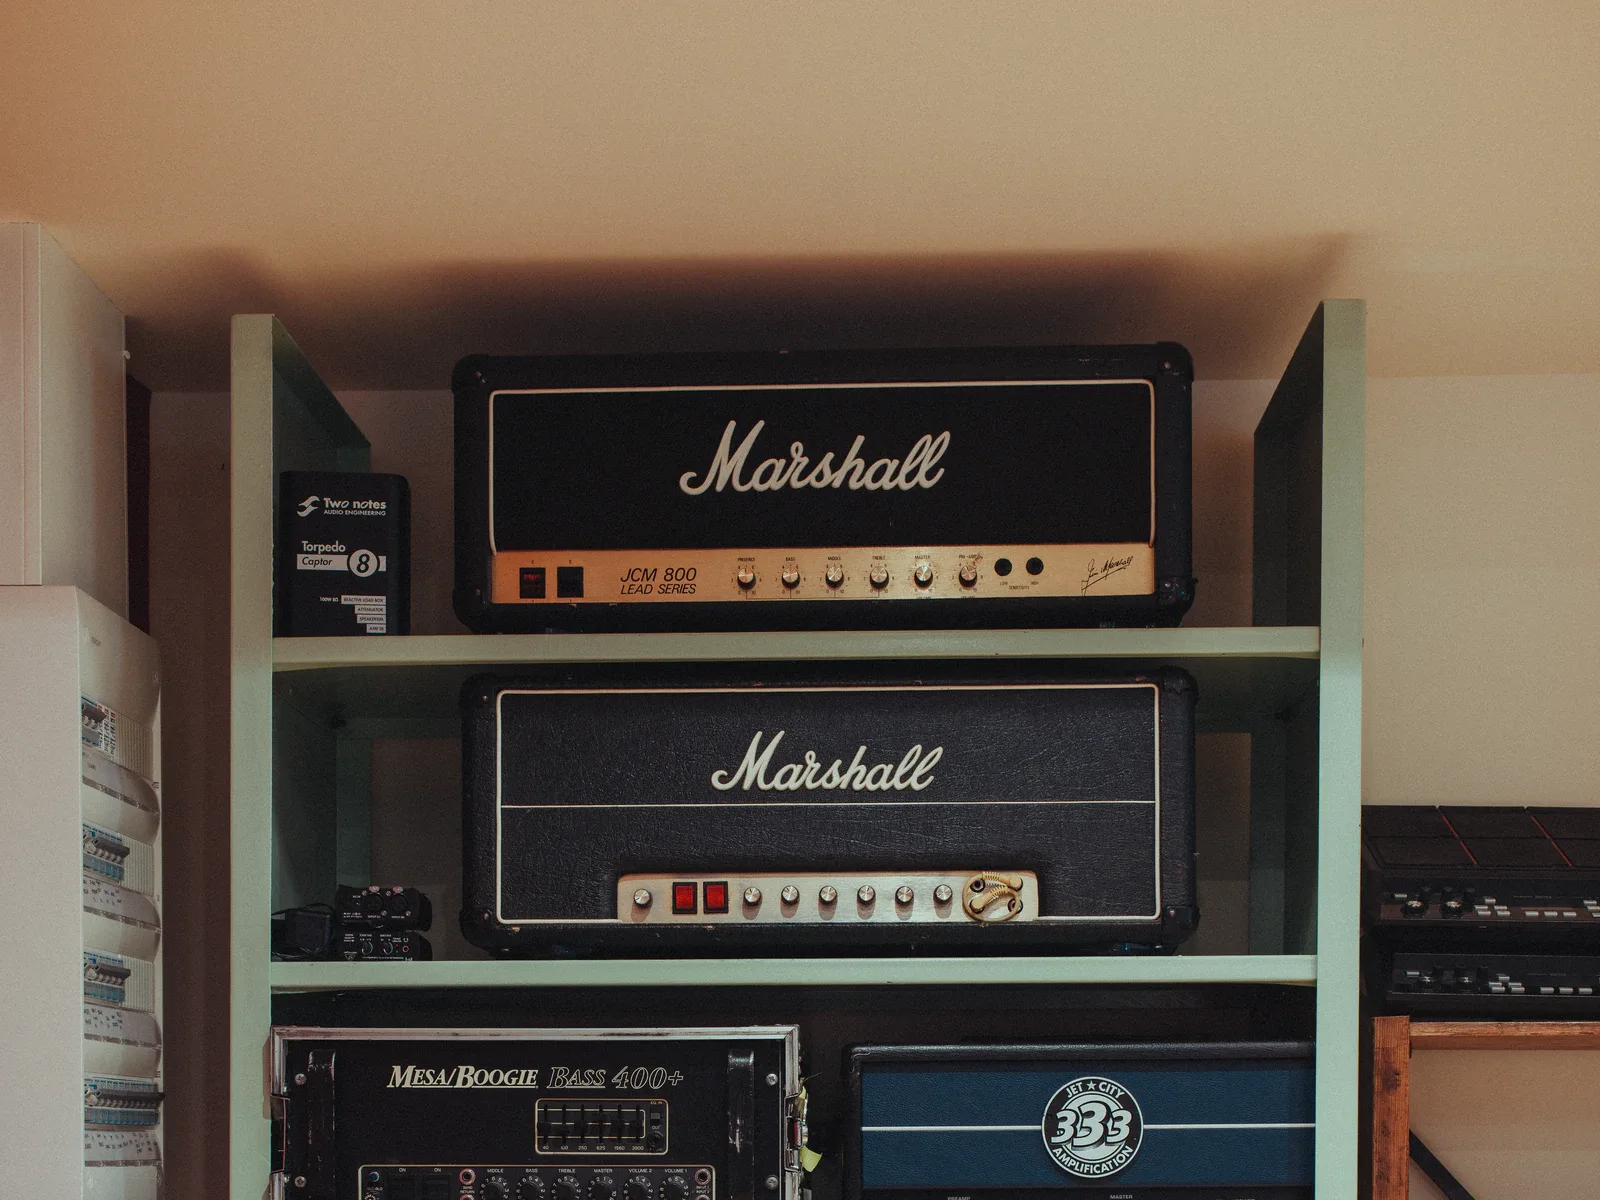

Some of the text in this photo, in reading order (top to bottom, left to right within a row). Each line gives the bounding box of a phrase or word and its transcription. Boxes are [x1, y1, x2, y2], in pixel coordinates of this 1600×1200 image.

[679, 420, 950, 495] Marshall
[324, 498, 386, 509] Two notes
[302, 541, 346, 554] Torpedo
[302, 557, 332, 568] Captor
[356, 554, 370, 573] 8
[620, 567, 697, 582] JCM 800
[620, 584, 697, 595] LEAD SERIES
[711, 730, 943, 791] Marshall
[546, 1066, 606, 1089] BASS
[611, 1065, 684, 1090] 400+
[1066, 1081, 1125, 1098] JET CITY
[1051, 1101, 1132, 1149] 333
[1053, 1145, 1134, 1173] AMPLIFICATION
